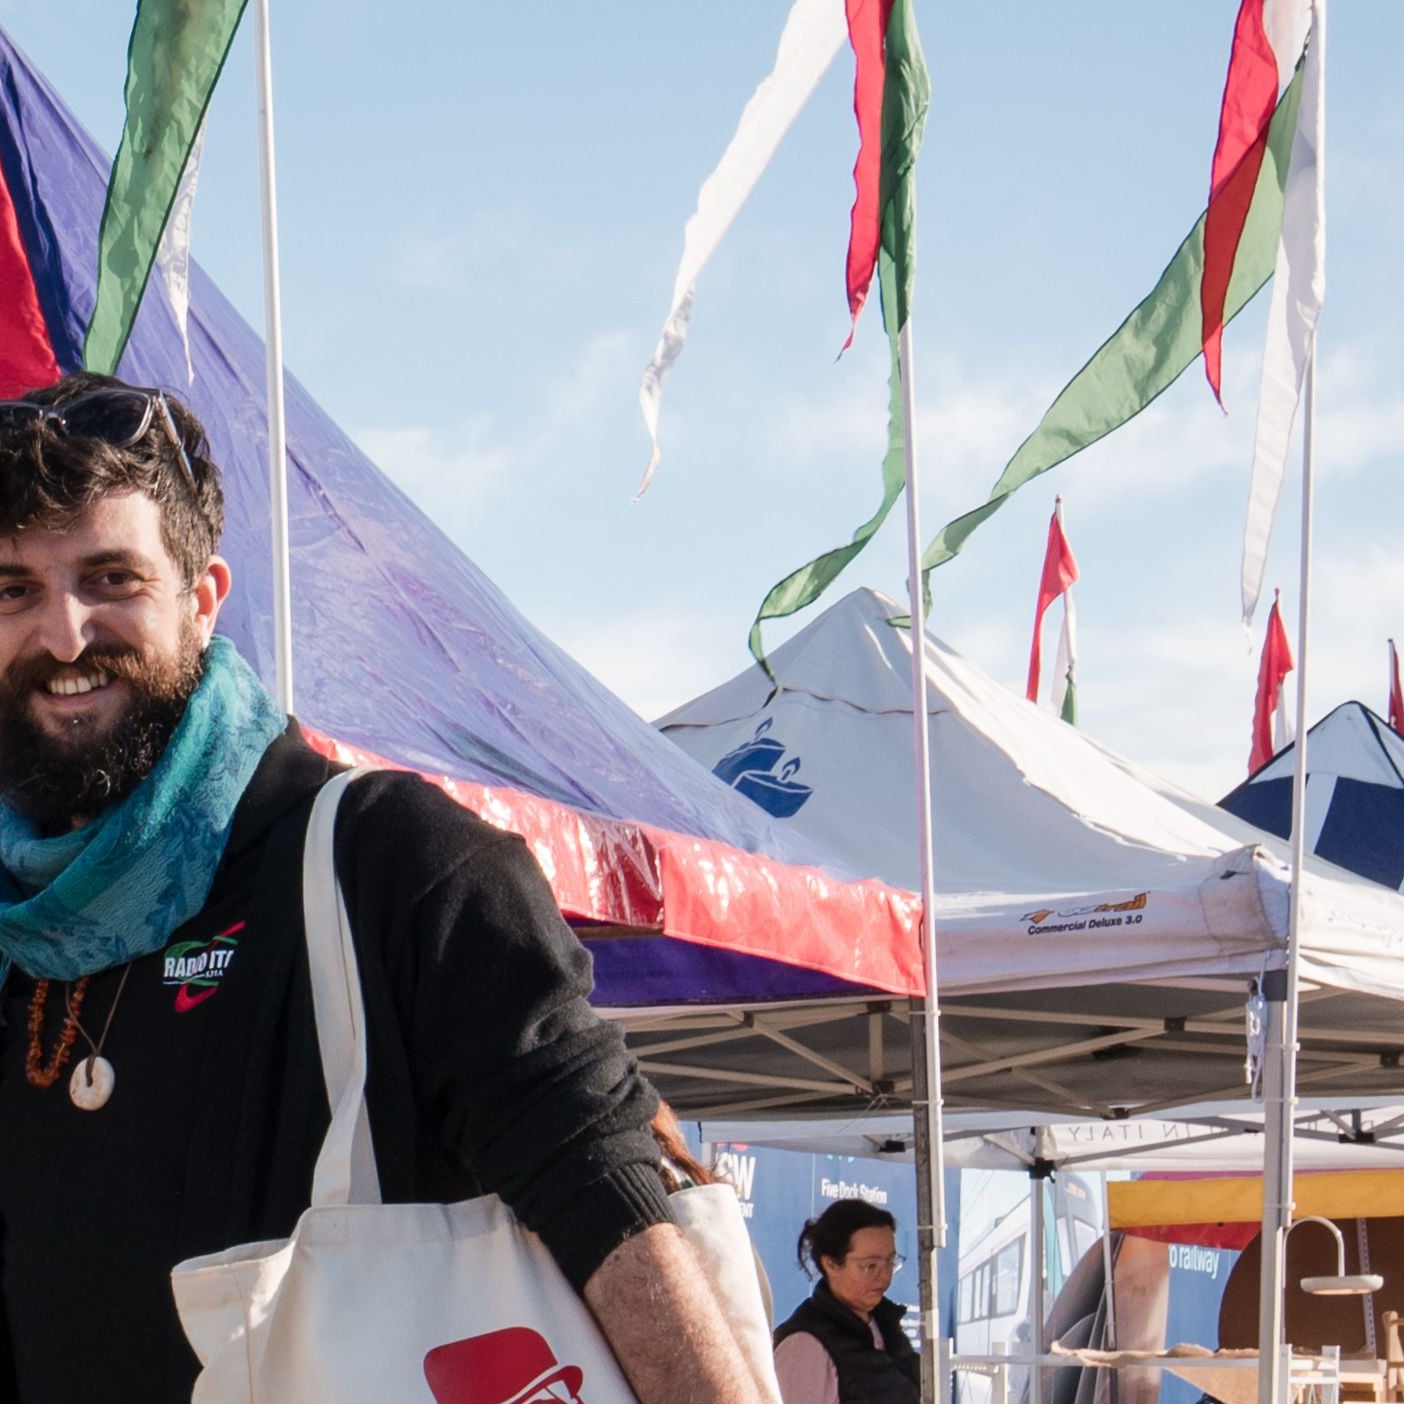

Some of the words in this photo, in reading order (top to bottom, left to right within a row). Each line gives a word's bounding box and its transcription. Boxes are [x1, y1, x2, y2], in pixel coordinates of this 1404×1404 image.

[1027, 919, 1087, 935] Commercial
[1088, 916, 1123, 930] Deluxe
[821, 1178, 839, 1199] Five
[839, 1180, 859, 1200] Dock
[859, 1183, 888, 1205] Station
[1178, 1245, 1221, 1280] railway
